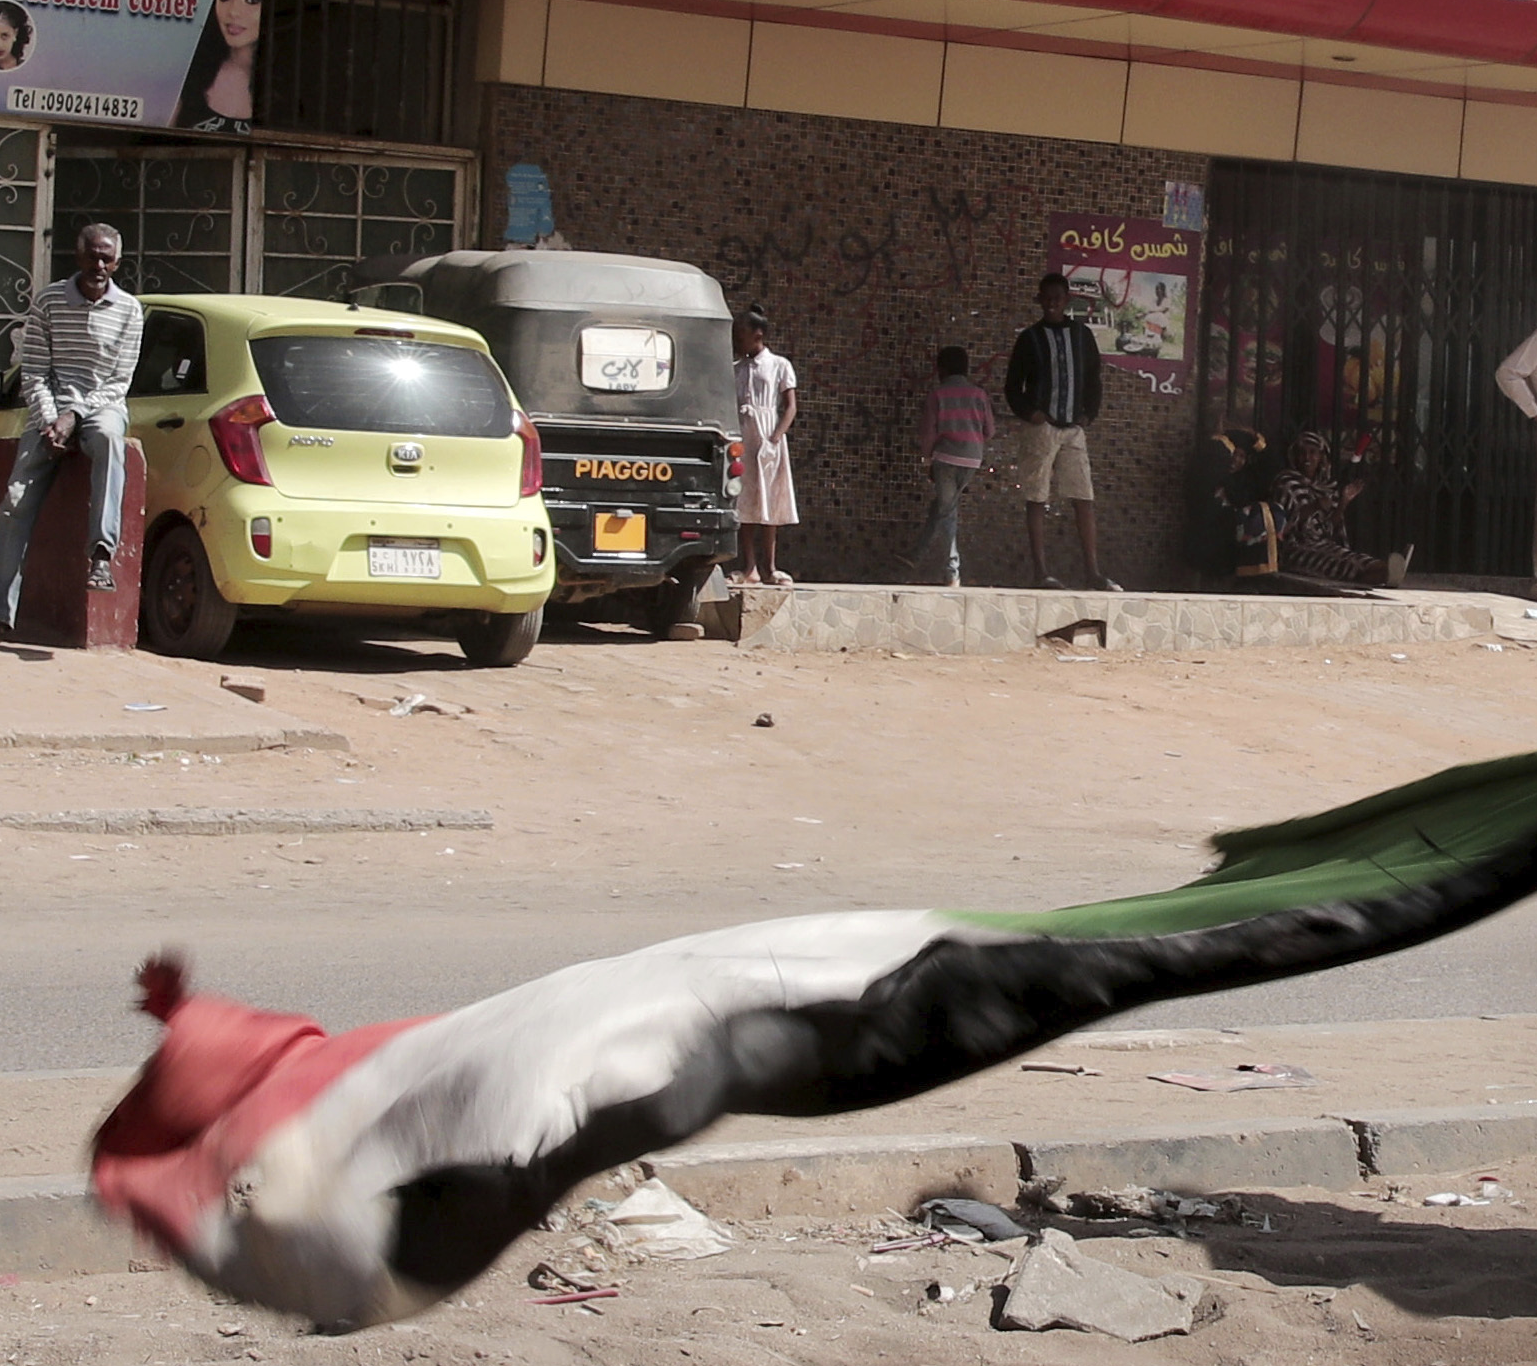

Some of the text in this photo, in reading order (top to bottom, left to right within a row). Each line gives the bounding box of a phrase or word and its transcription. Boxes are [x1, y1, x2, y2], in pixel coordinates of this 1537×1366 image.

[13, 88, 36, 110] Tel
[396, 448, 419, 460] KIA
[575, 459, 673, 482] PIAGGIO
